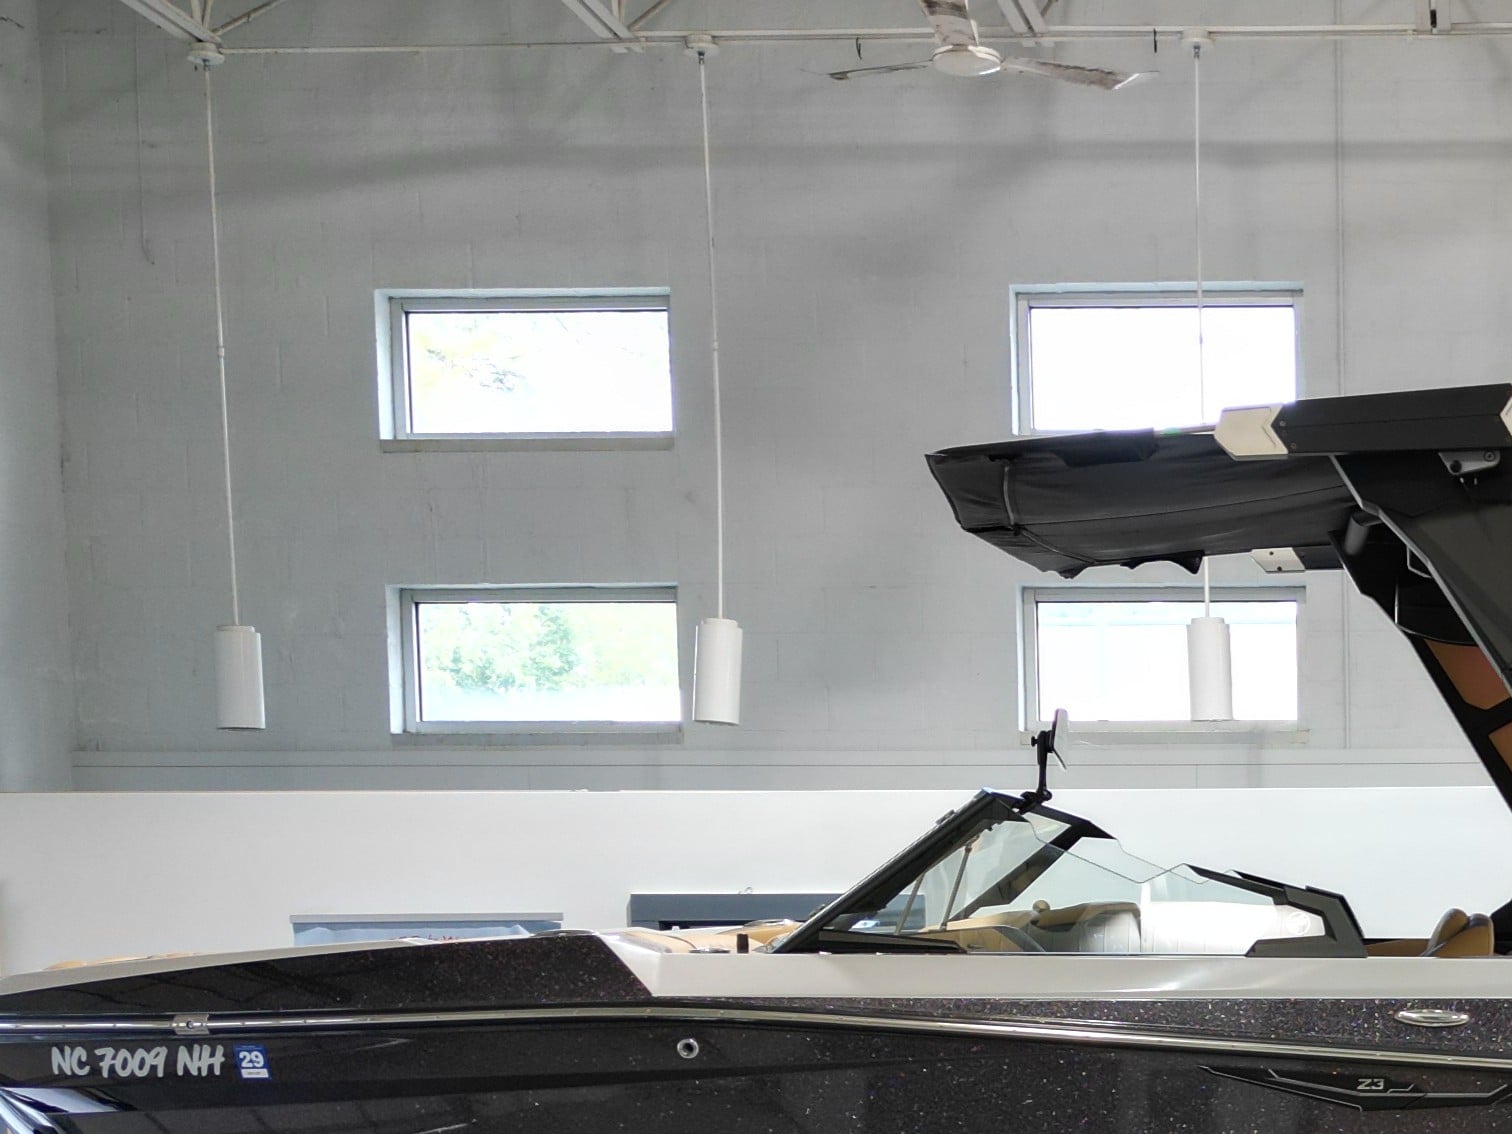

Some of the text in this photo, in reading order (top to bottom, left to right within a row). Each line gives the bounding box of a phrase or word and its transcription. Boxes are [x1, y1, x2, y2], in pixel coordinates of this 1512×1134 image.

[51, 1044, 225, 1079] NC 7009 NH
[239, 1051, 264, 1068] 29
